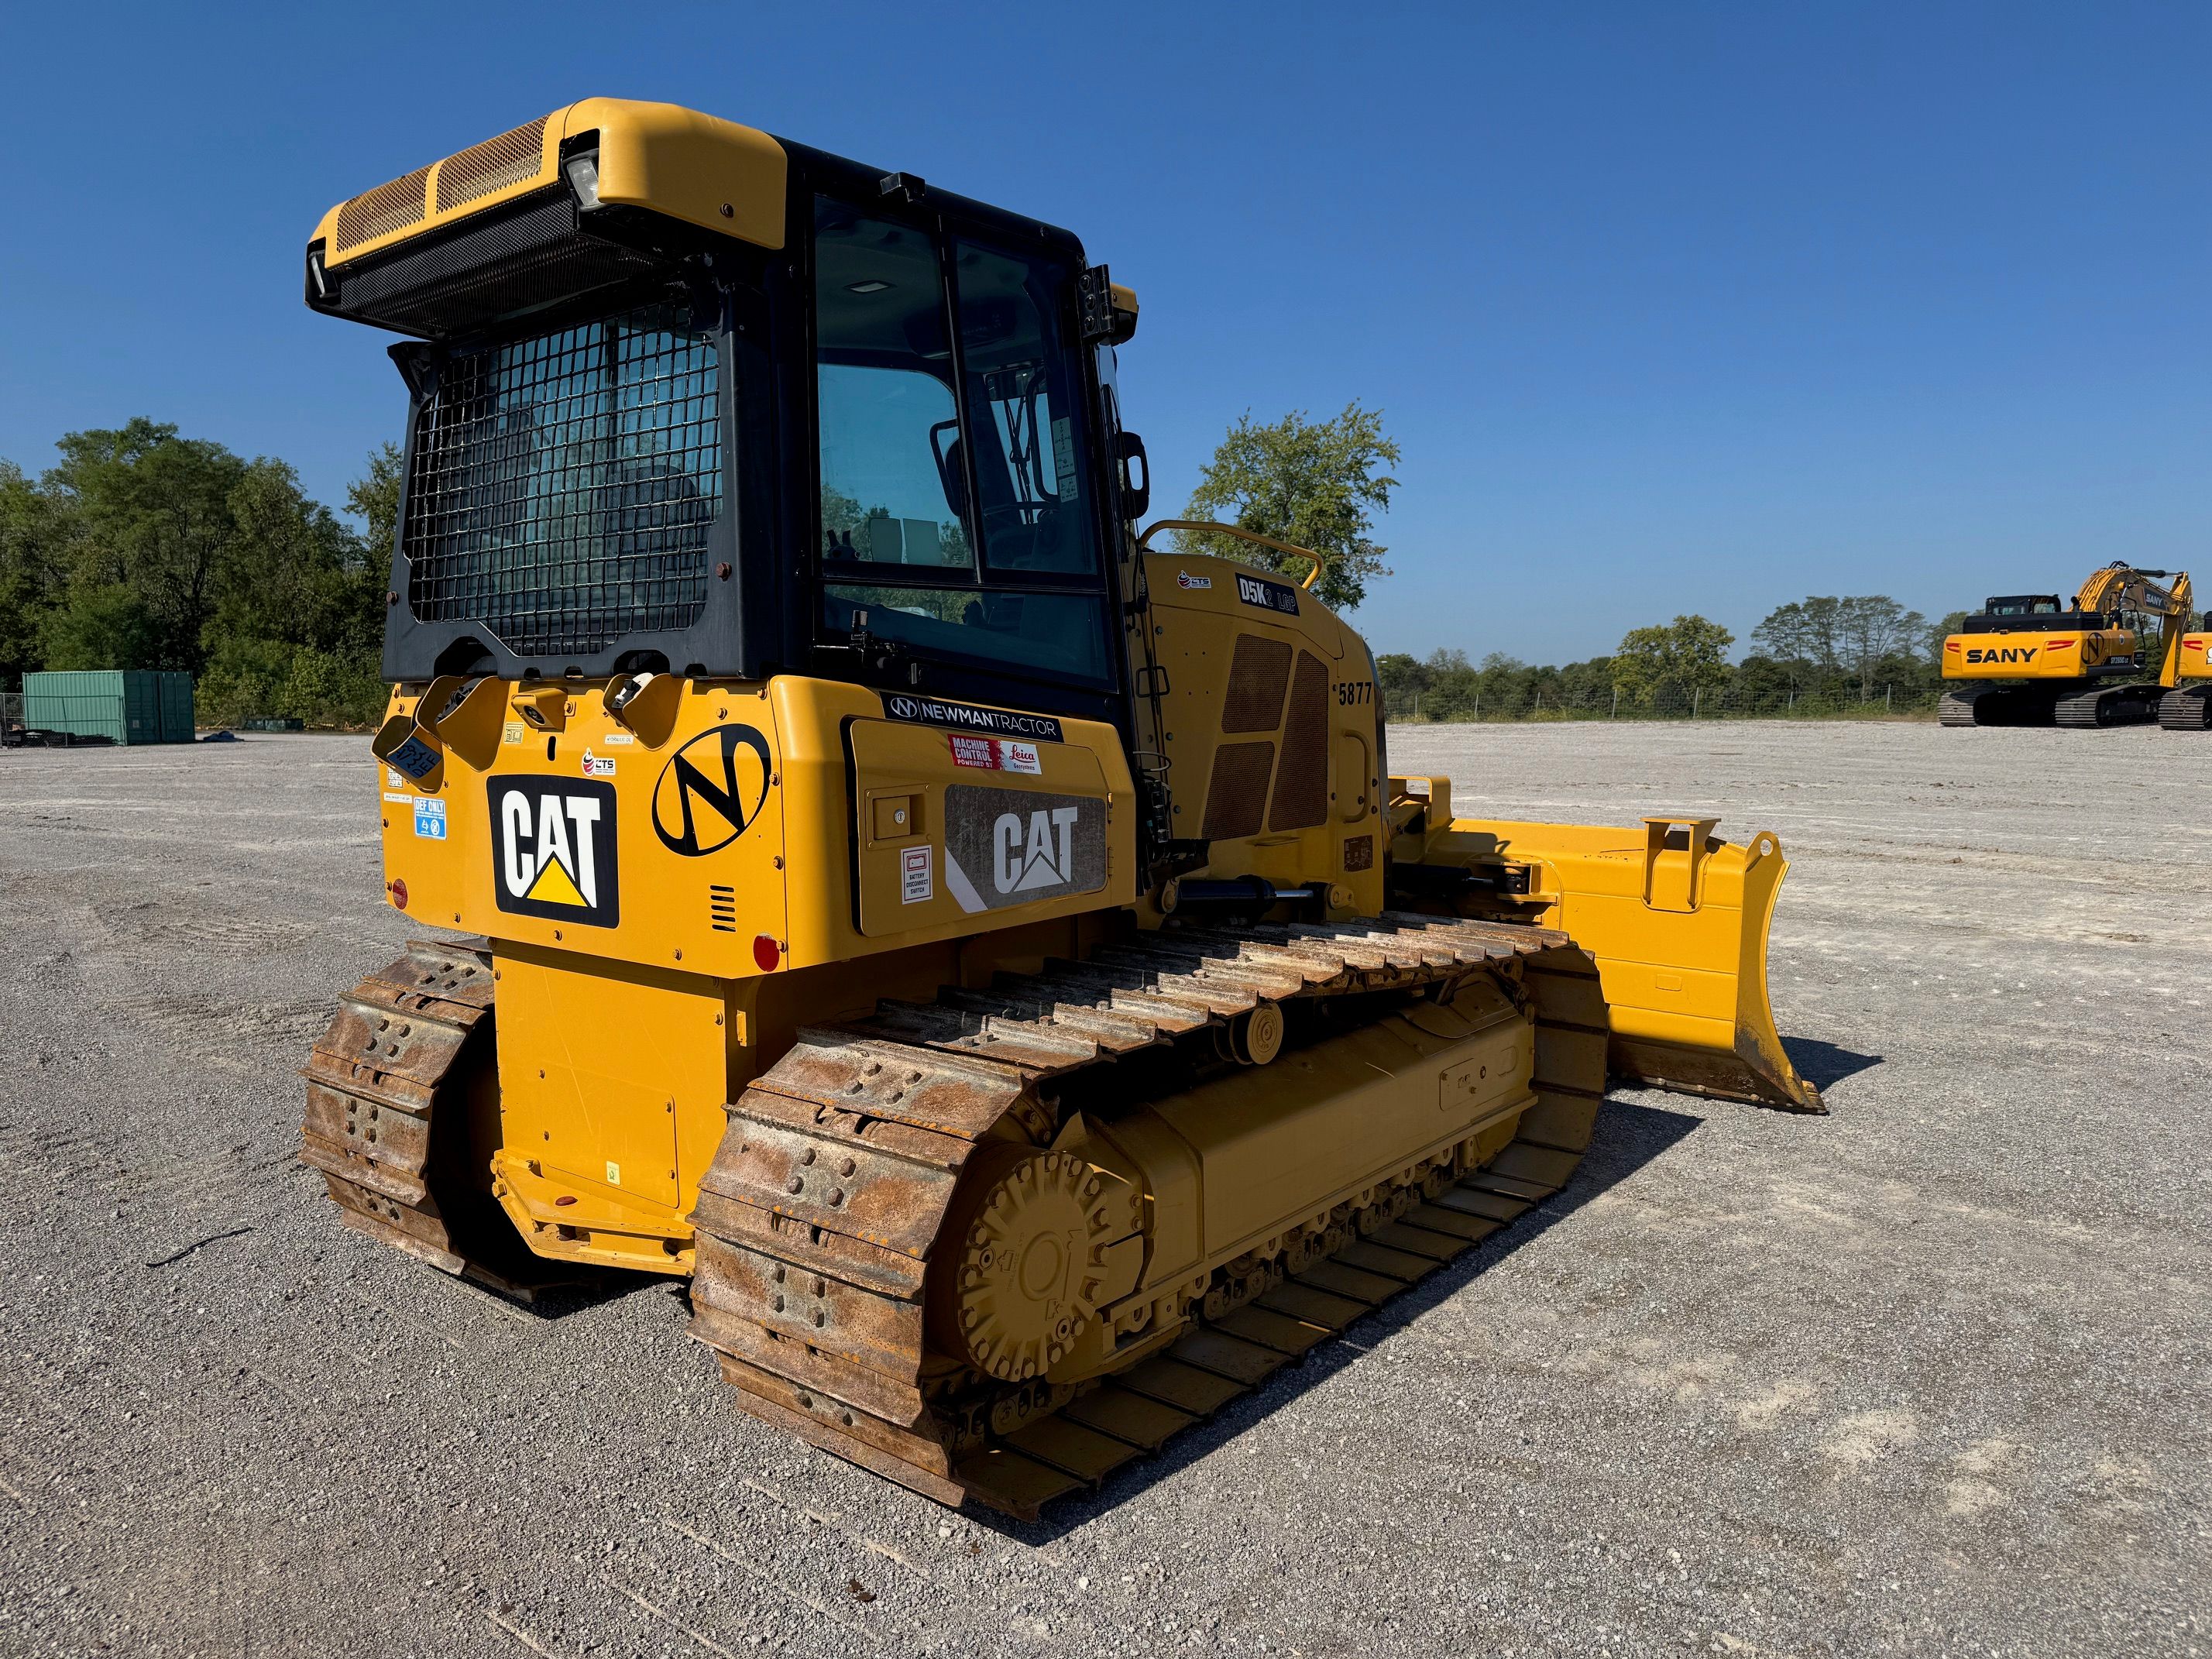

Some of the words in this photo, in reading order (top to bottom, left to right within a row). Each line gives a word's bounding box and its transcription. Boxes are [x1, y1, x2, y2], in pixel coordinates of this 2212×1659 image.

[1239, 578, 1273, 607] D5K2
[1277, 592, 1296, 612] LGP
[2145, 593, 2163, 606] SANY
[1966, 648, 2038, 663] SANY
[1338, 682, 1372, 706] 5877
[952, 737, 989, 751] MACHINE
[954, 747, 992, 761] CONTROL
[1009, 744, 1036, 763] Leica
[412, 754, 436, 778] DEF
[596, 760, 613, 768] CTS
[957, 759, 984, 768] POWERED
[415, 799, 427, 811] DEF
[428, 801, 444, 812] ONLY
[502, 790, 600, 908] CAT
[994, 806, 1078, 894] CAT
[906, 879, 929, 888] DISCONNECT
